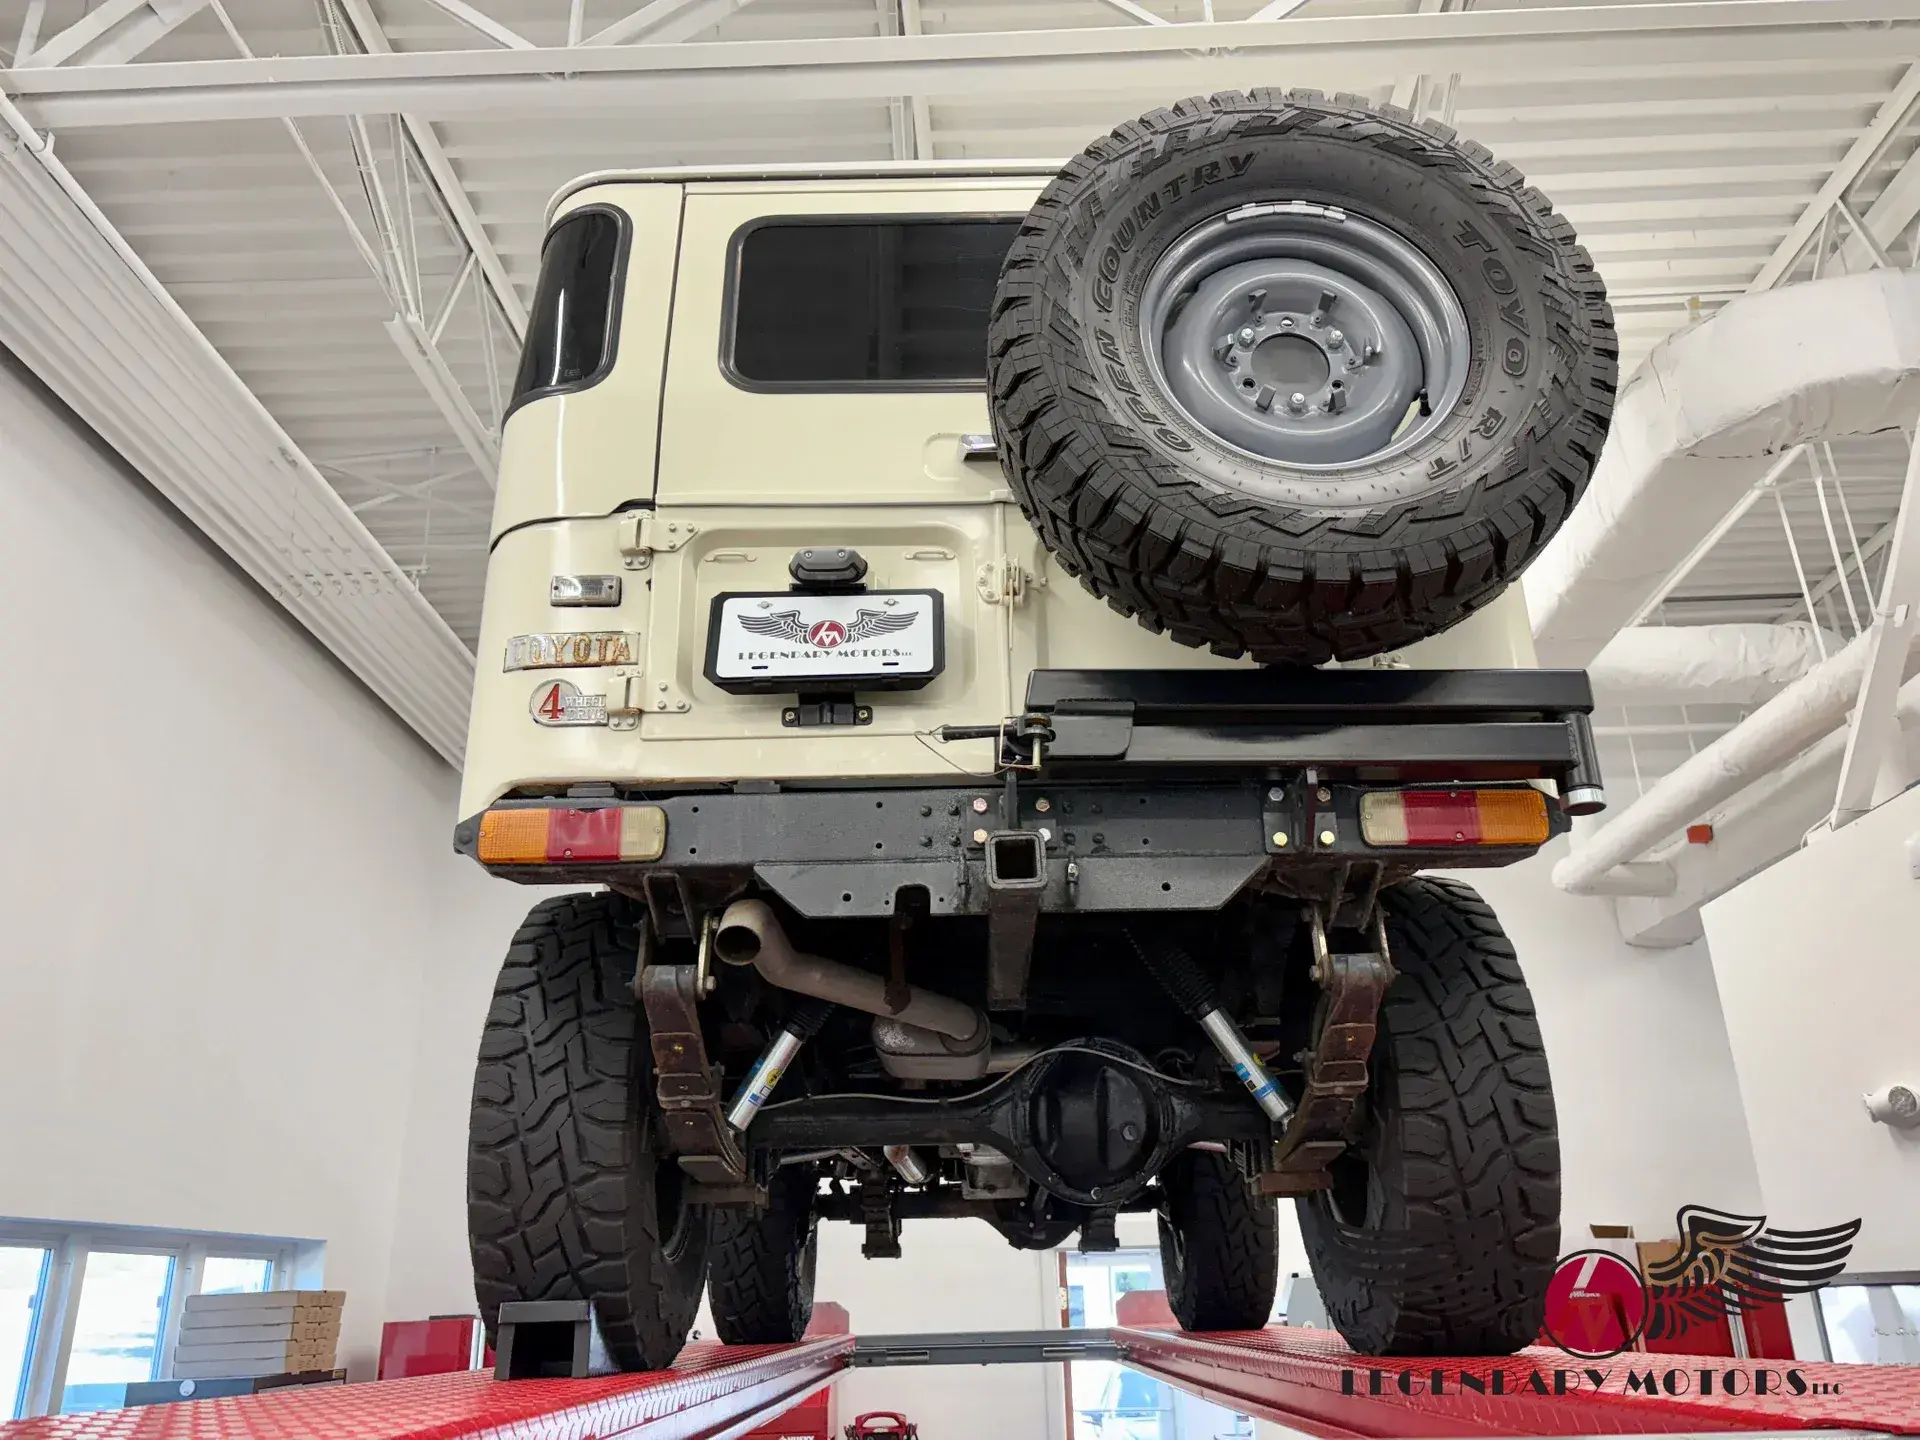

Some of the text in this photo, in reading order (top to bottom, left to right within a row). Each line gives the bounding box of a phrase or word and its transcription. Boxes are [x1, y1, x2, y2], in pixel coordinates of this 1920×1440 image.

[1093, 151, 1258, 315] COUNTRY
[1452, 219, 1531, 377] TOYO
[1091, 328, 1195, 452] OPEN
[512, 633, 631, 664] TOYOTA
[738, 650, 834, 660] LEGENDARY
[836, 648, 900, 658] MOTORS
[538, 682, 565, 720] 4
[564, 696, 606, 707] WHEEL
[565, 708, 605, 720] DRIVE
